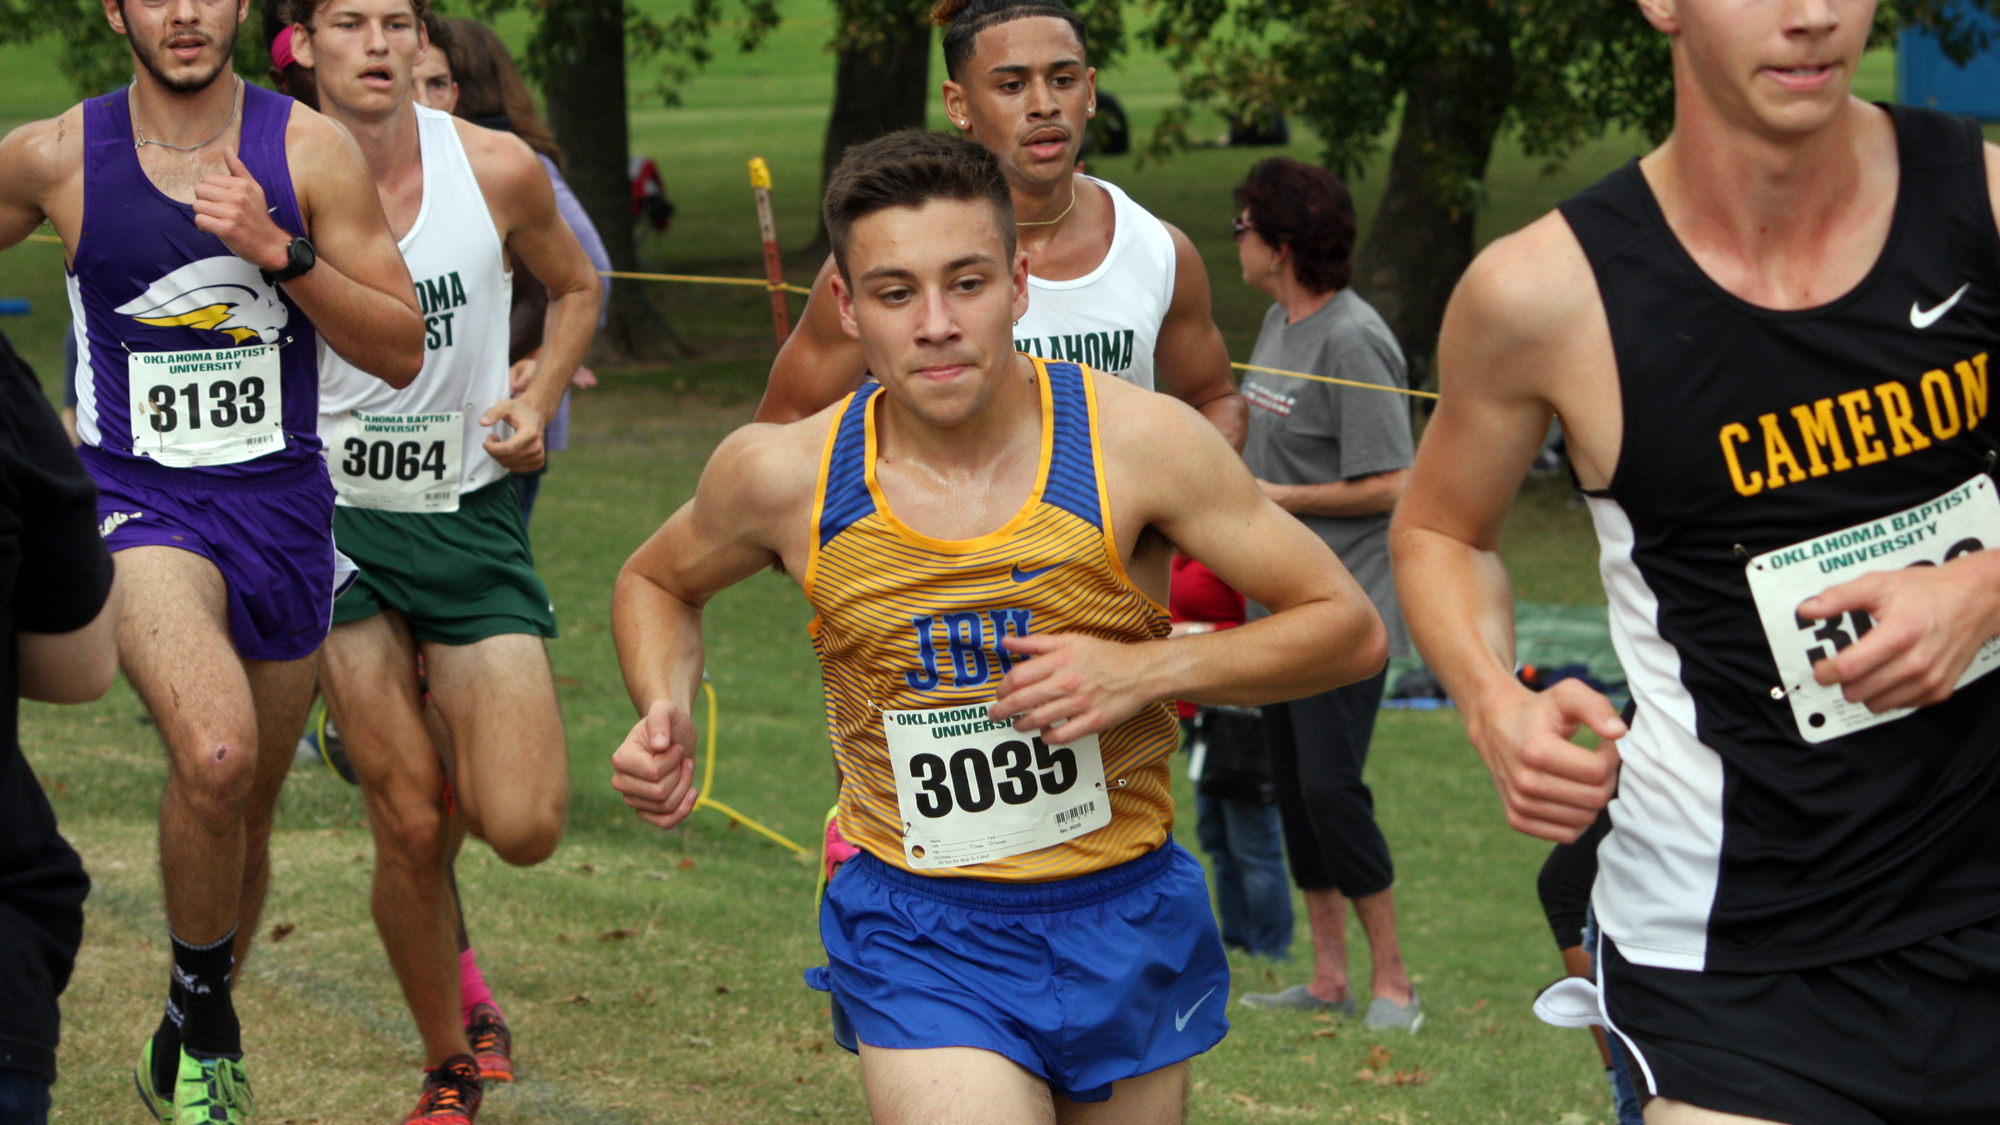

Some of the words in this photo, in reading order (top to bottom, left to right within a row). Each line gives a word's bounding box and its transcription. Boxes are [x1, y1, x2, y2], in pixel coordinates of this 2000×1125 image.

[143, 352, 213, 364] OKLAHOMA
[216, 347, 267, 360] BAPTIST
[169, 361, 242, 374] UNIVERSITY
[148, 376, 265, 433] 3133
[406, 414, 452, 424] BAPTIST
[1719, 352, 1989, 497] CAMERON
[364, 424, 429, 433] UNIVERSITY
[342, 437, 447, 481] 3064
[1770, 523, 1887, 570] OKLAHOMA
[1891, 485, 1973, 532] BAPTIST
[1818, 521, 1939, 574] UNIVERSITY
[896, 706, 988, 726] OKLAHOMA
[909, 736, 1078, 819] 3035
